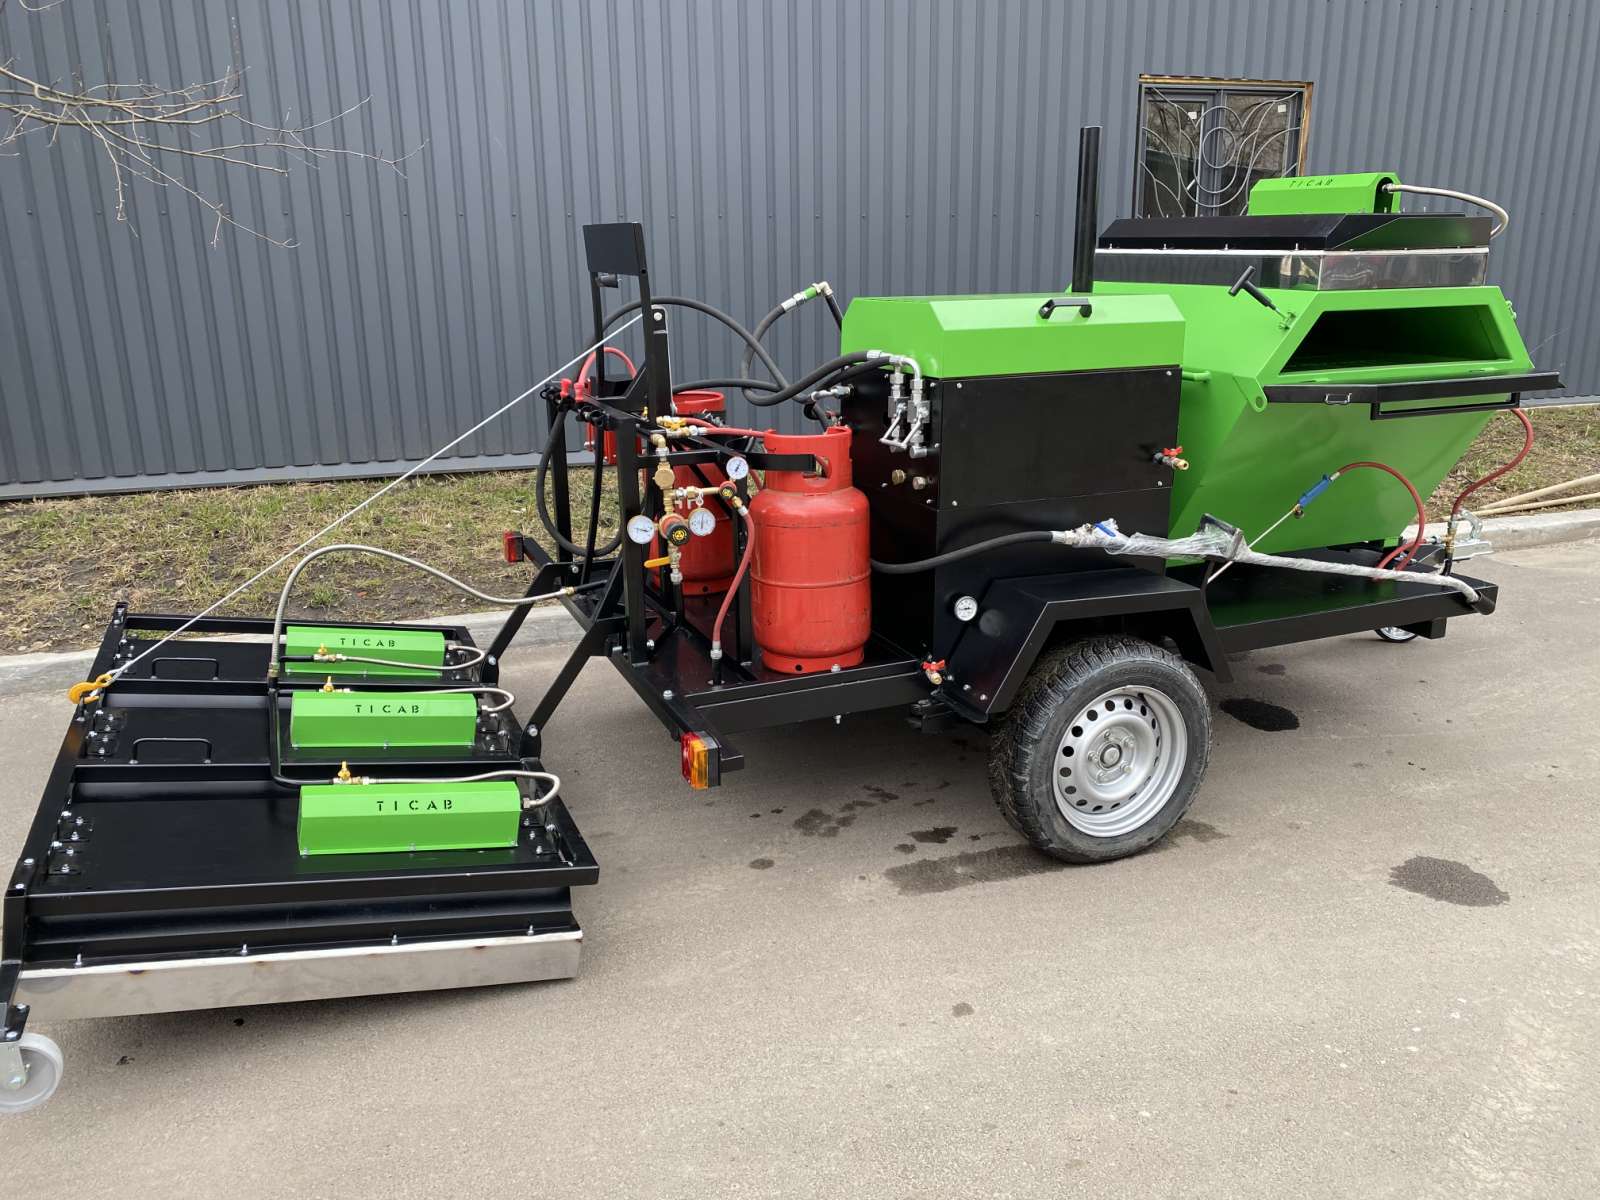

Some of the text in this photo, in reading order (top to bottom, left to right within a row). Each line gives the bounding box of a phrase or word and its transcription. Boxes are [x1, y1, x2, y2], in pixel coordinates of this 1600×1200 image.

[1289, 178, 1334, 189] TICAB
[340, 638, 395, 647] TICAB
[355, 704, 420, 714] TICAB
[376, 799, 453, 812] TICAB
